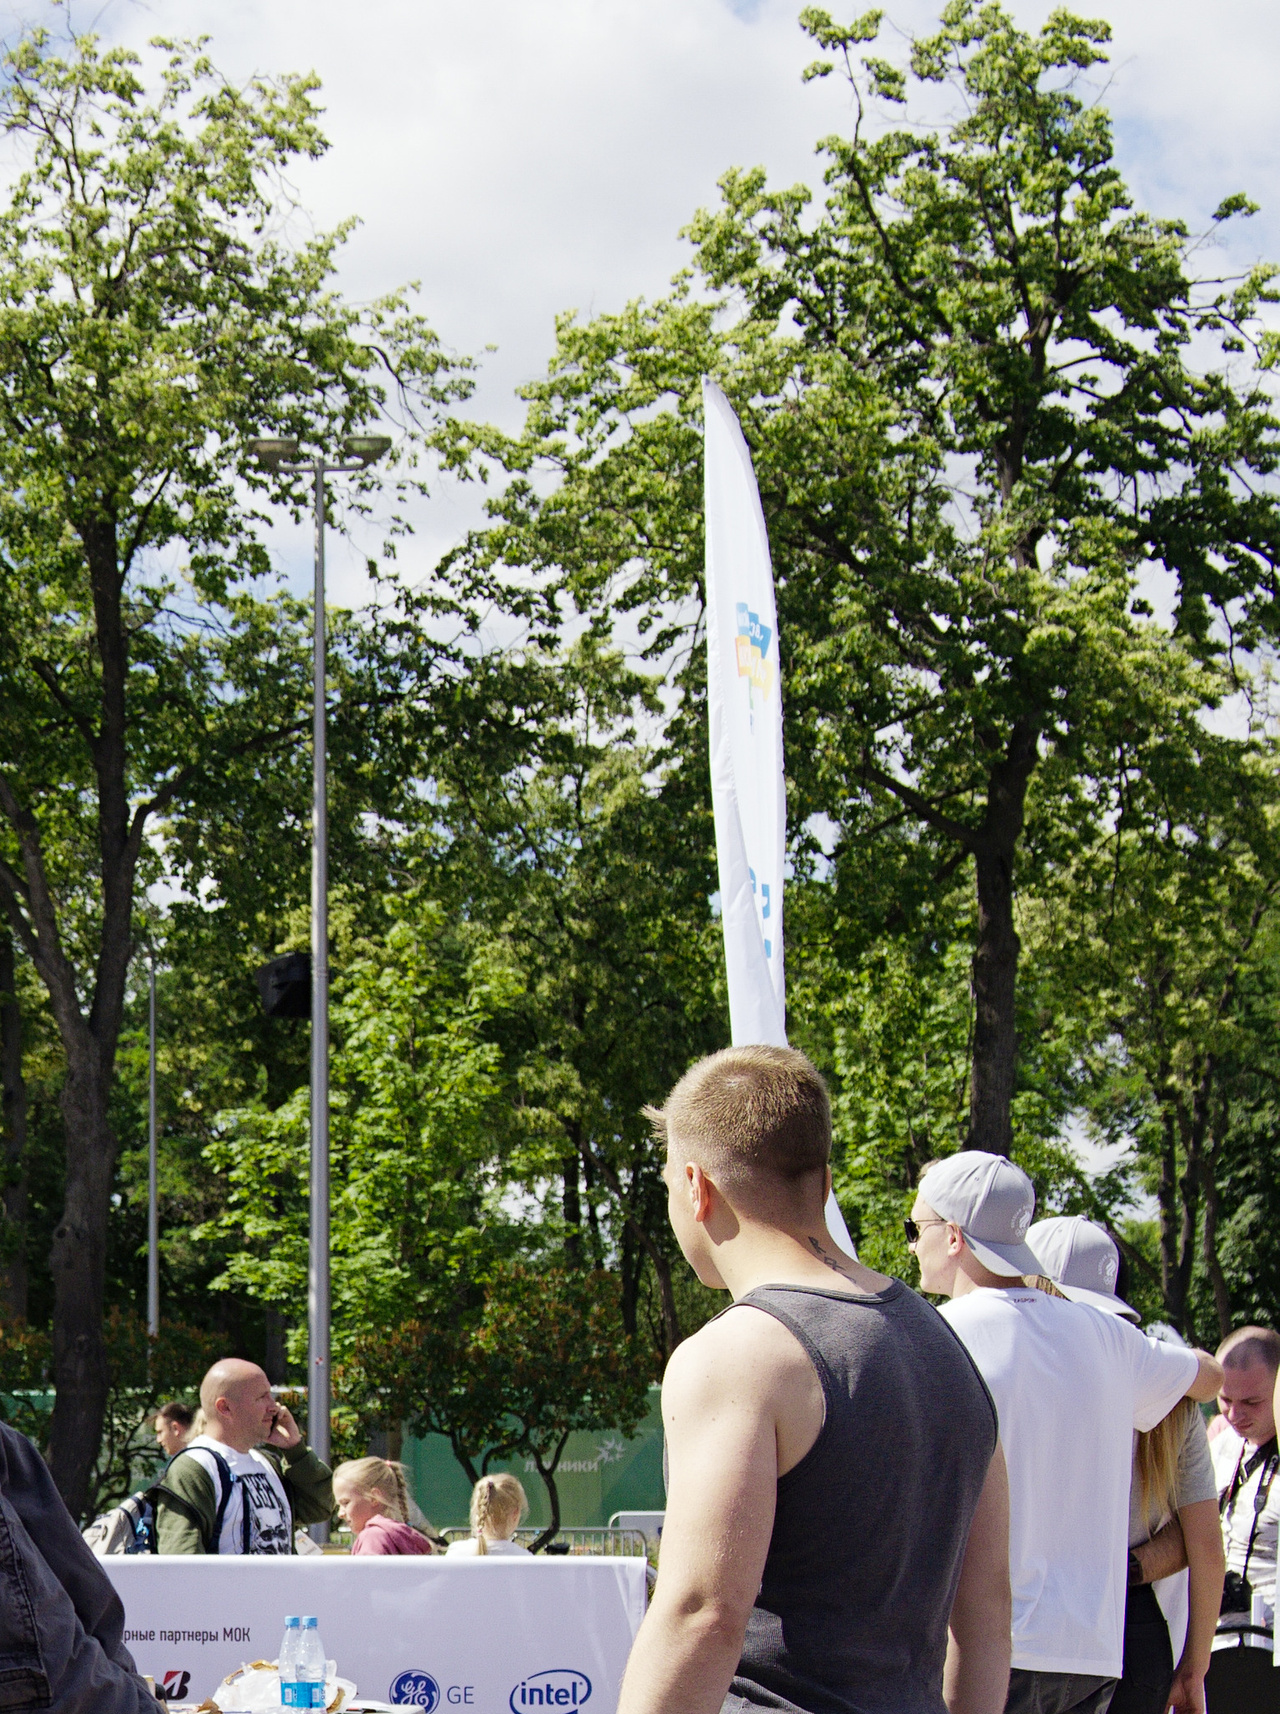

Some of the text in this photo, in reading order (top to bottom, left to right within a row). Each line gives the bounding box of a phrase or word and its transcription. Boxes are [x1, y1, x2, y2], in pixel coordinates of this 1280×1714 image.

[159, 1629, 219, 1645] партнеры
[223, 1627, 251, 1642] МОК
[446, 1686, 475, 1704] GE
[521, 1681, 577, 1706] intel
